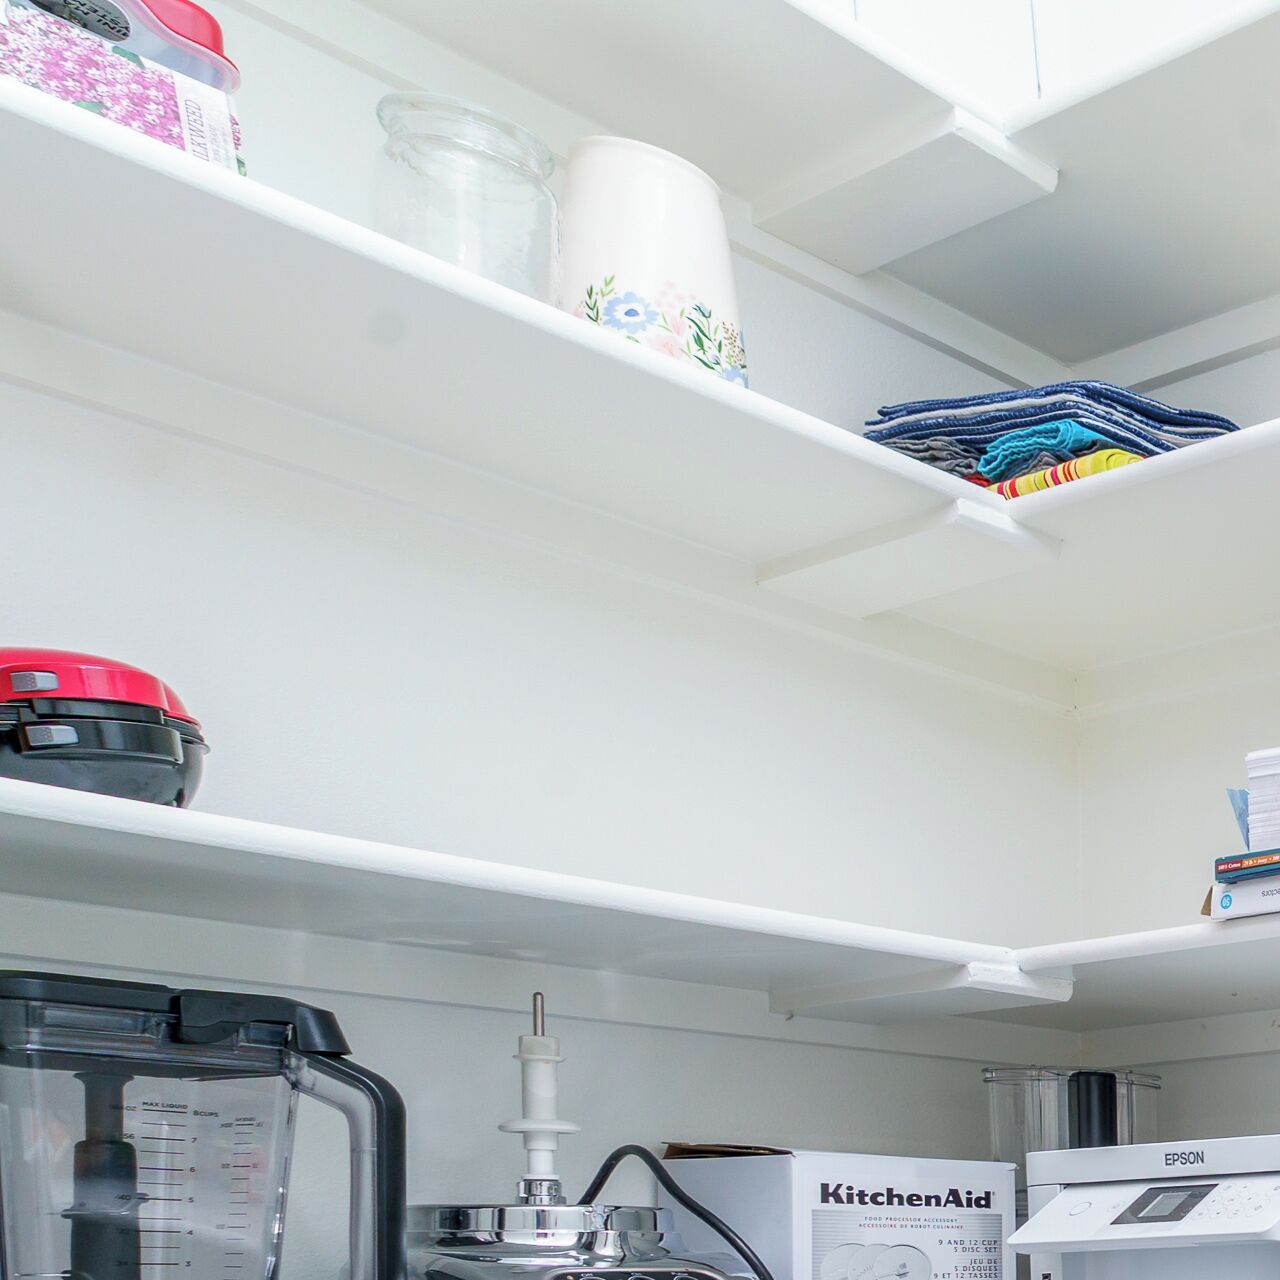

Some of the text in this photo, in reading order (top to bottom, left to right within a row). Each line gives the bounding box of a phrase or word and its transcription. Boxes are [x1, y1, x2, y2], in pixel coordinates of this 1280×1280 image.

[161, 1102, 188, 1110] LIQUID
[1165, 1151, 1204, 1166] EPSON
[820, 1183, 992, 1209] KitchenAid
